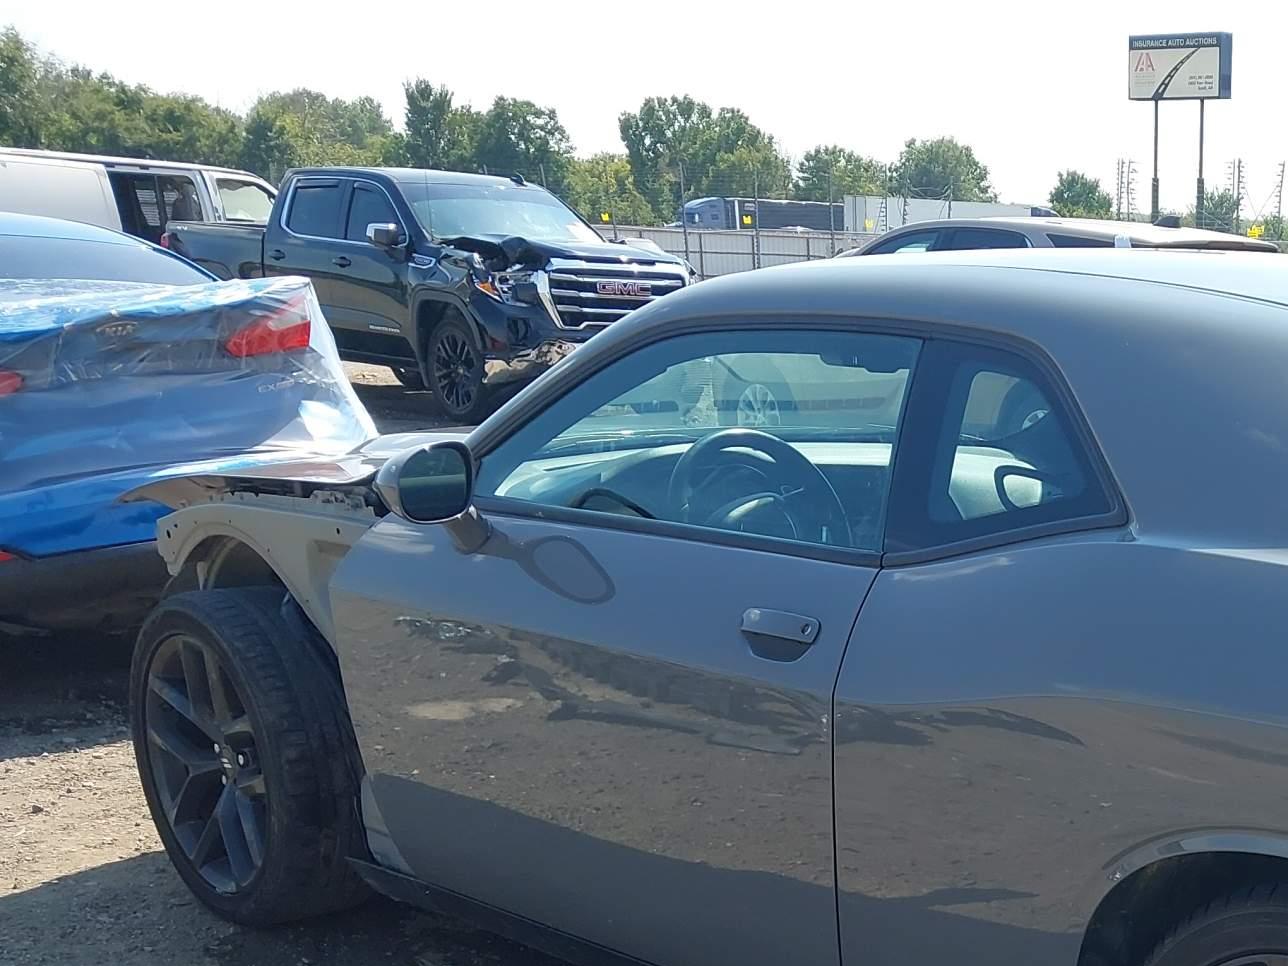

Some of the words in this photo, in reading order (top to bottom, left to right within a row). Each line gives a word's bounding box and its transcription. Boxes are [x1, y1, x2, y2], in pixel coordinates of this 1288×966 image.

[1132, 39, 1167, 48] INSURANCE
[1168, 38, 1185, 47] AUTO
[1186, 37, 1217, 46] AUCTIONS
[596, 280, 652, 296] GMC
